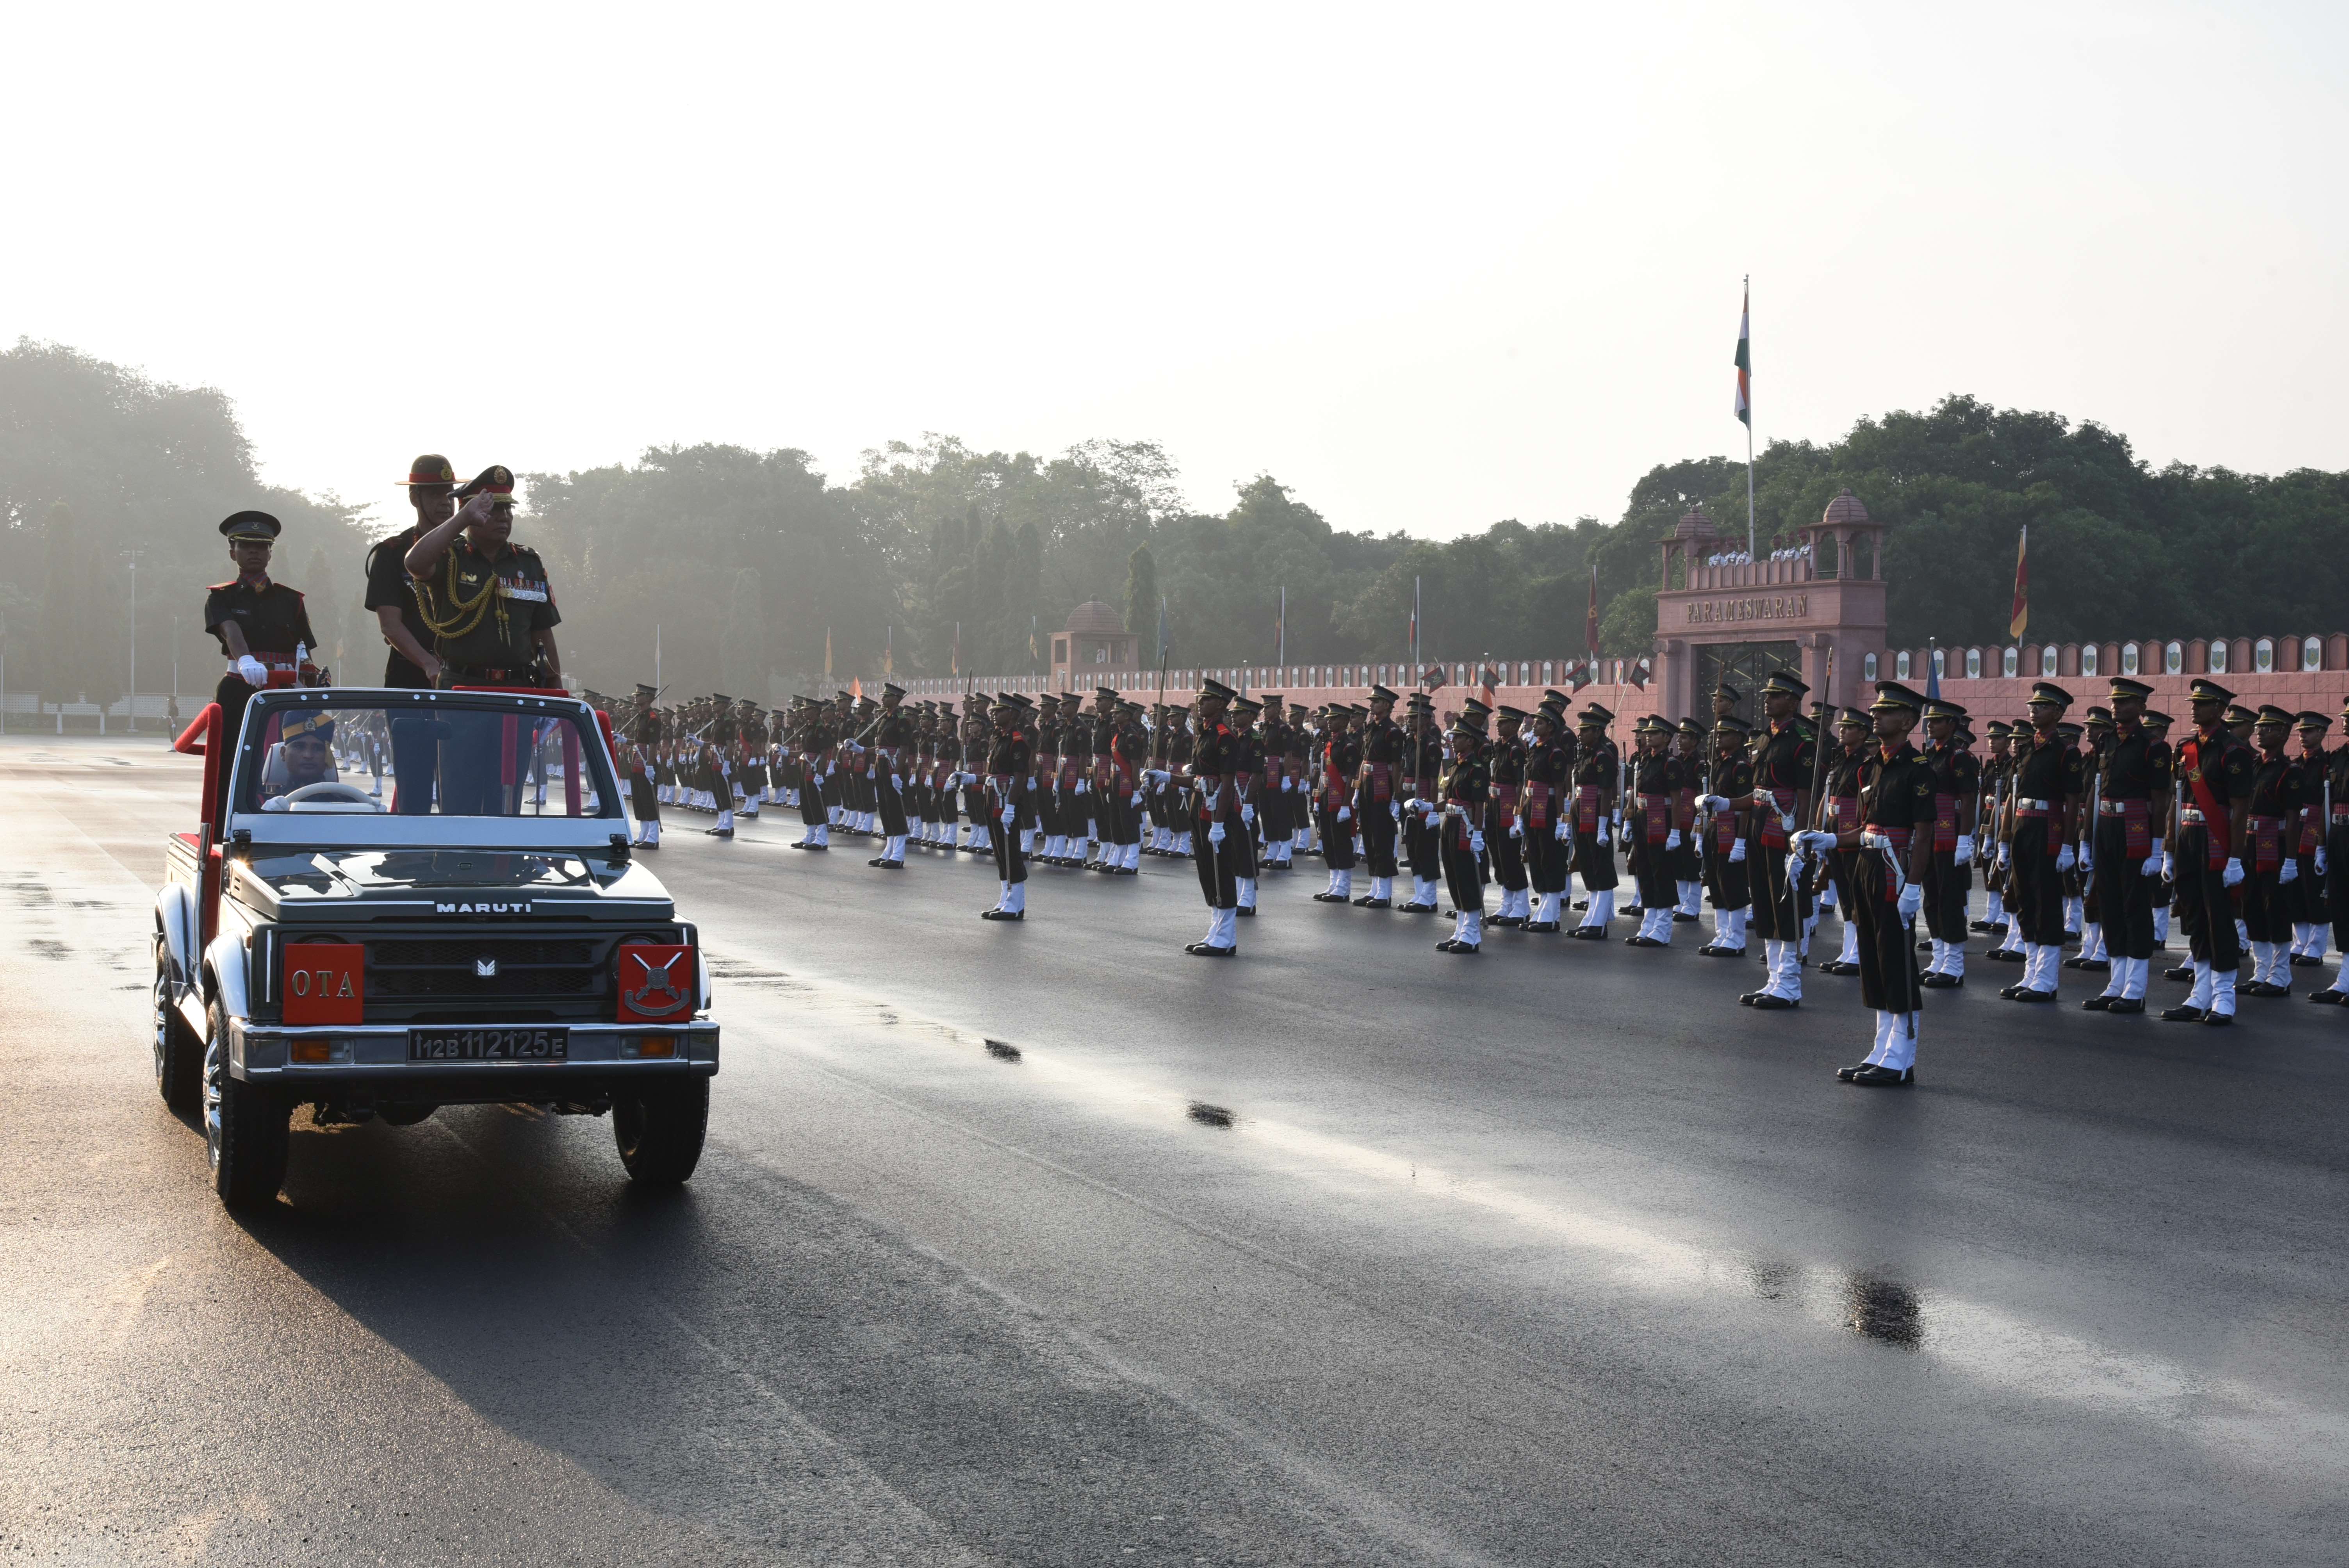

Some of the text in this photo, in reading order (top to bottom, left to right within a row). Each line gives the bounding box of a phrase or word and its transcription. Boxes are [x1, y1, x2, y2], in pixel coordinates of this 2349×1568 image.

[1686, 595, 1807, 623] PARAMESWARAN
[437, 903, 531, 912] MARUTI
[292, 970, 355, 997] OTA
